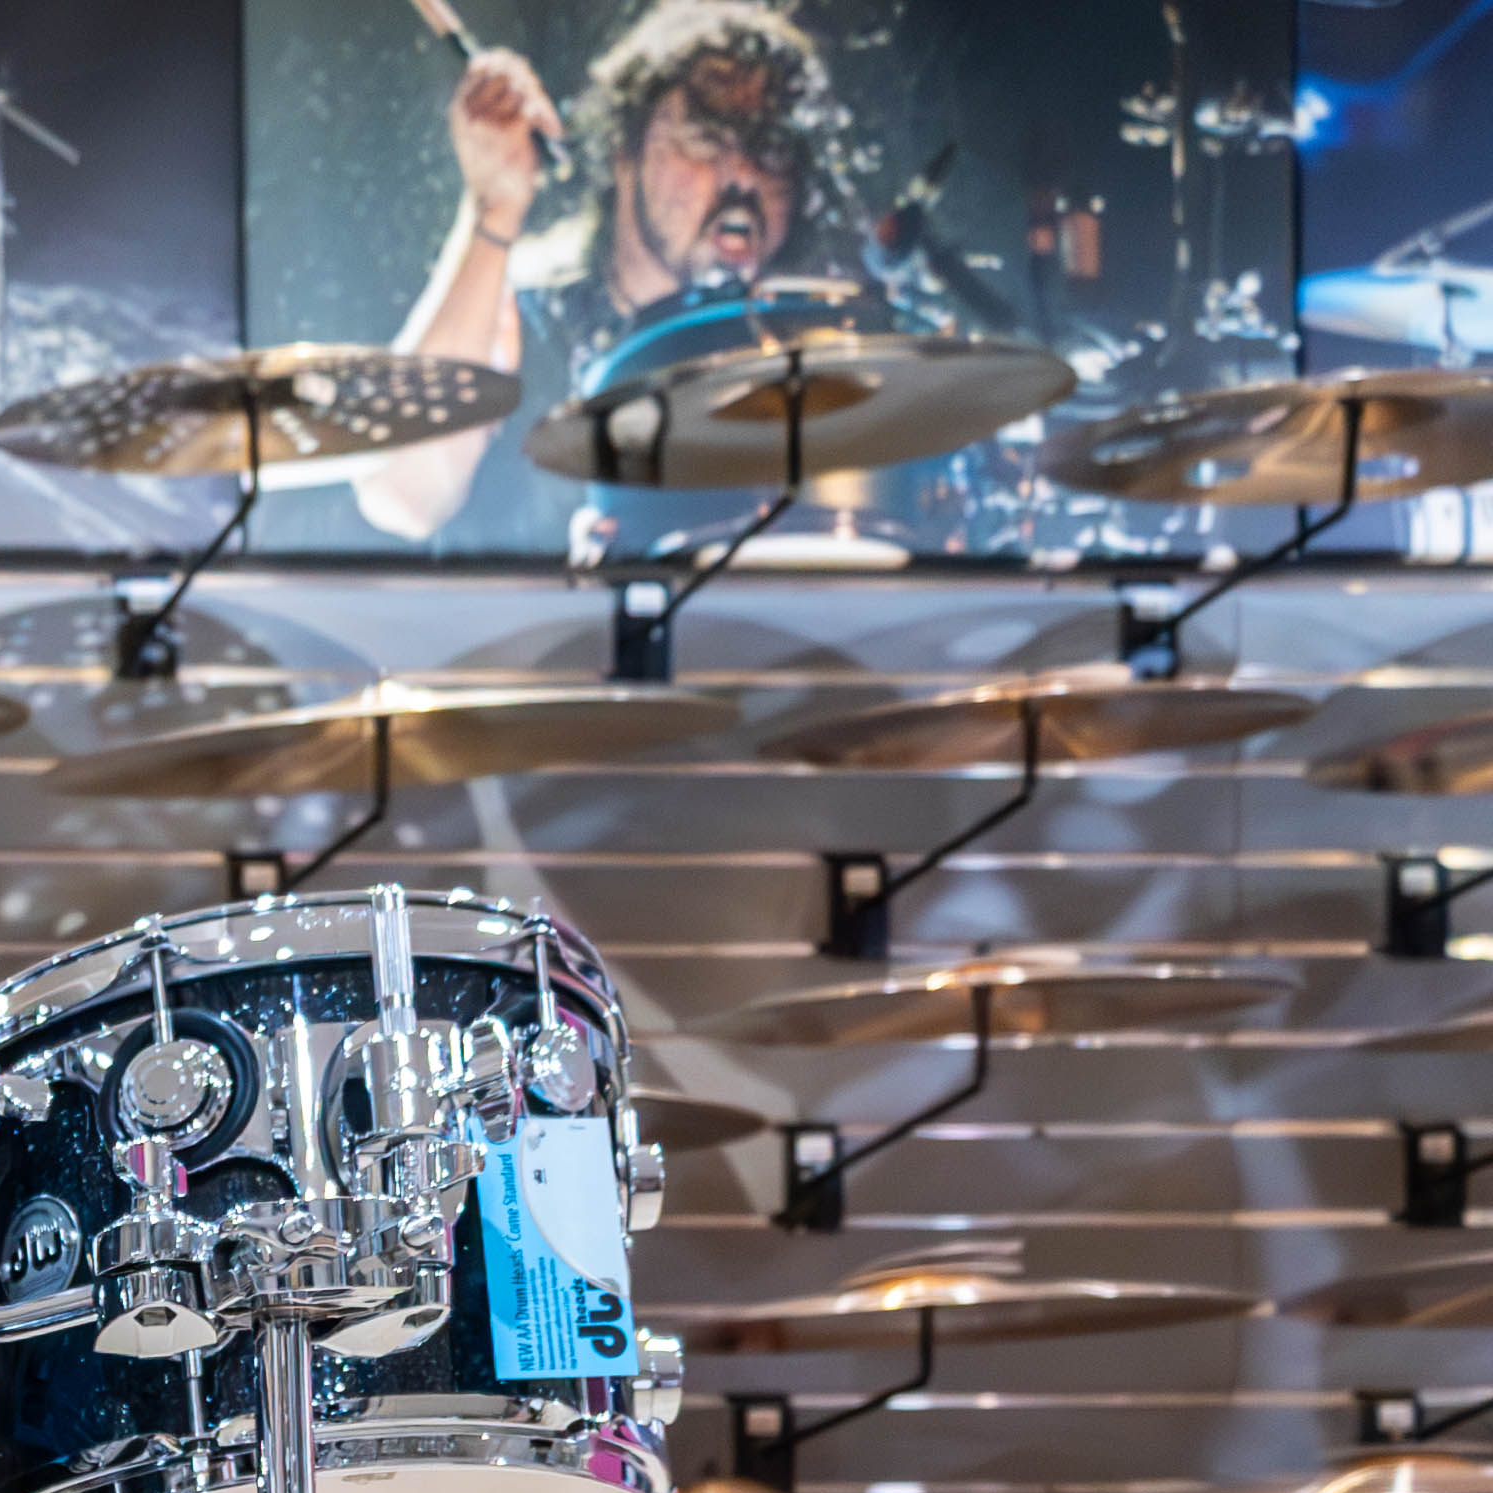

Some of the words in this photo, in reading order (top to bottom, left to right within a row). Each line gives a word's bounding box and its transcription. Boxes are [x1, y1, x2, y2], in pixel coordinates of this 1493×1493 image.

[497, 1153, 517, 1206] Standard
[506, 1207, 521, 1242] Come
[9, 1230, 63, 1283] dw
[515, 1287, 530, 1321] Drum
[570, 1277, 588, 1324] heads
[517, 1342, 535, 1371] NEW
